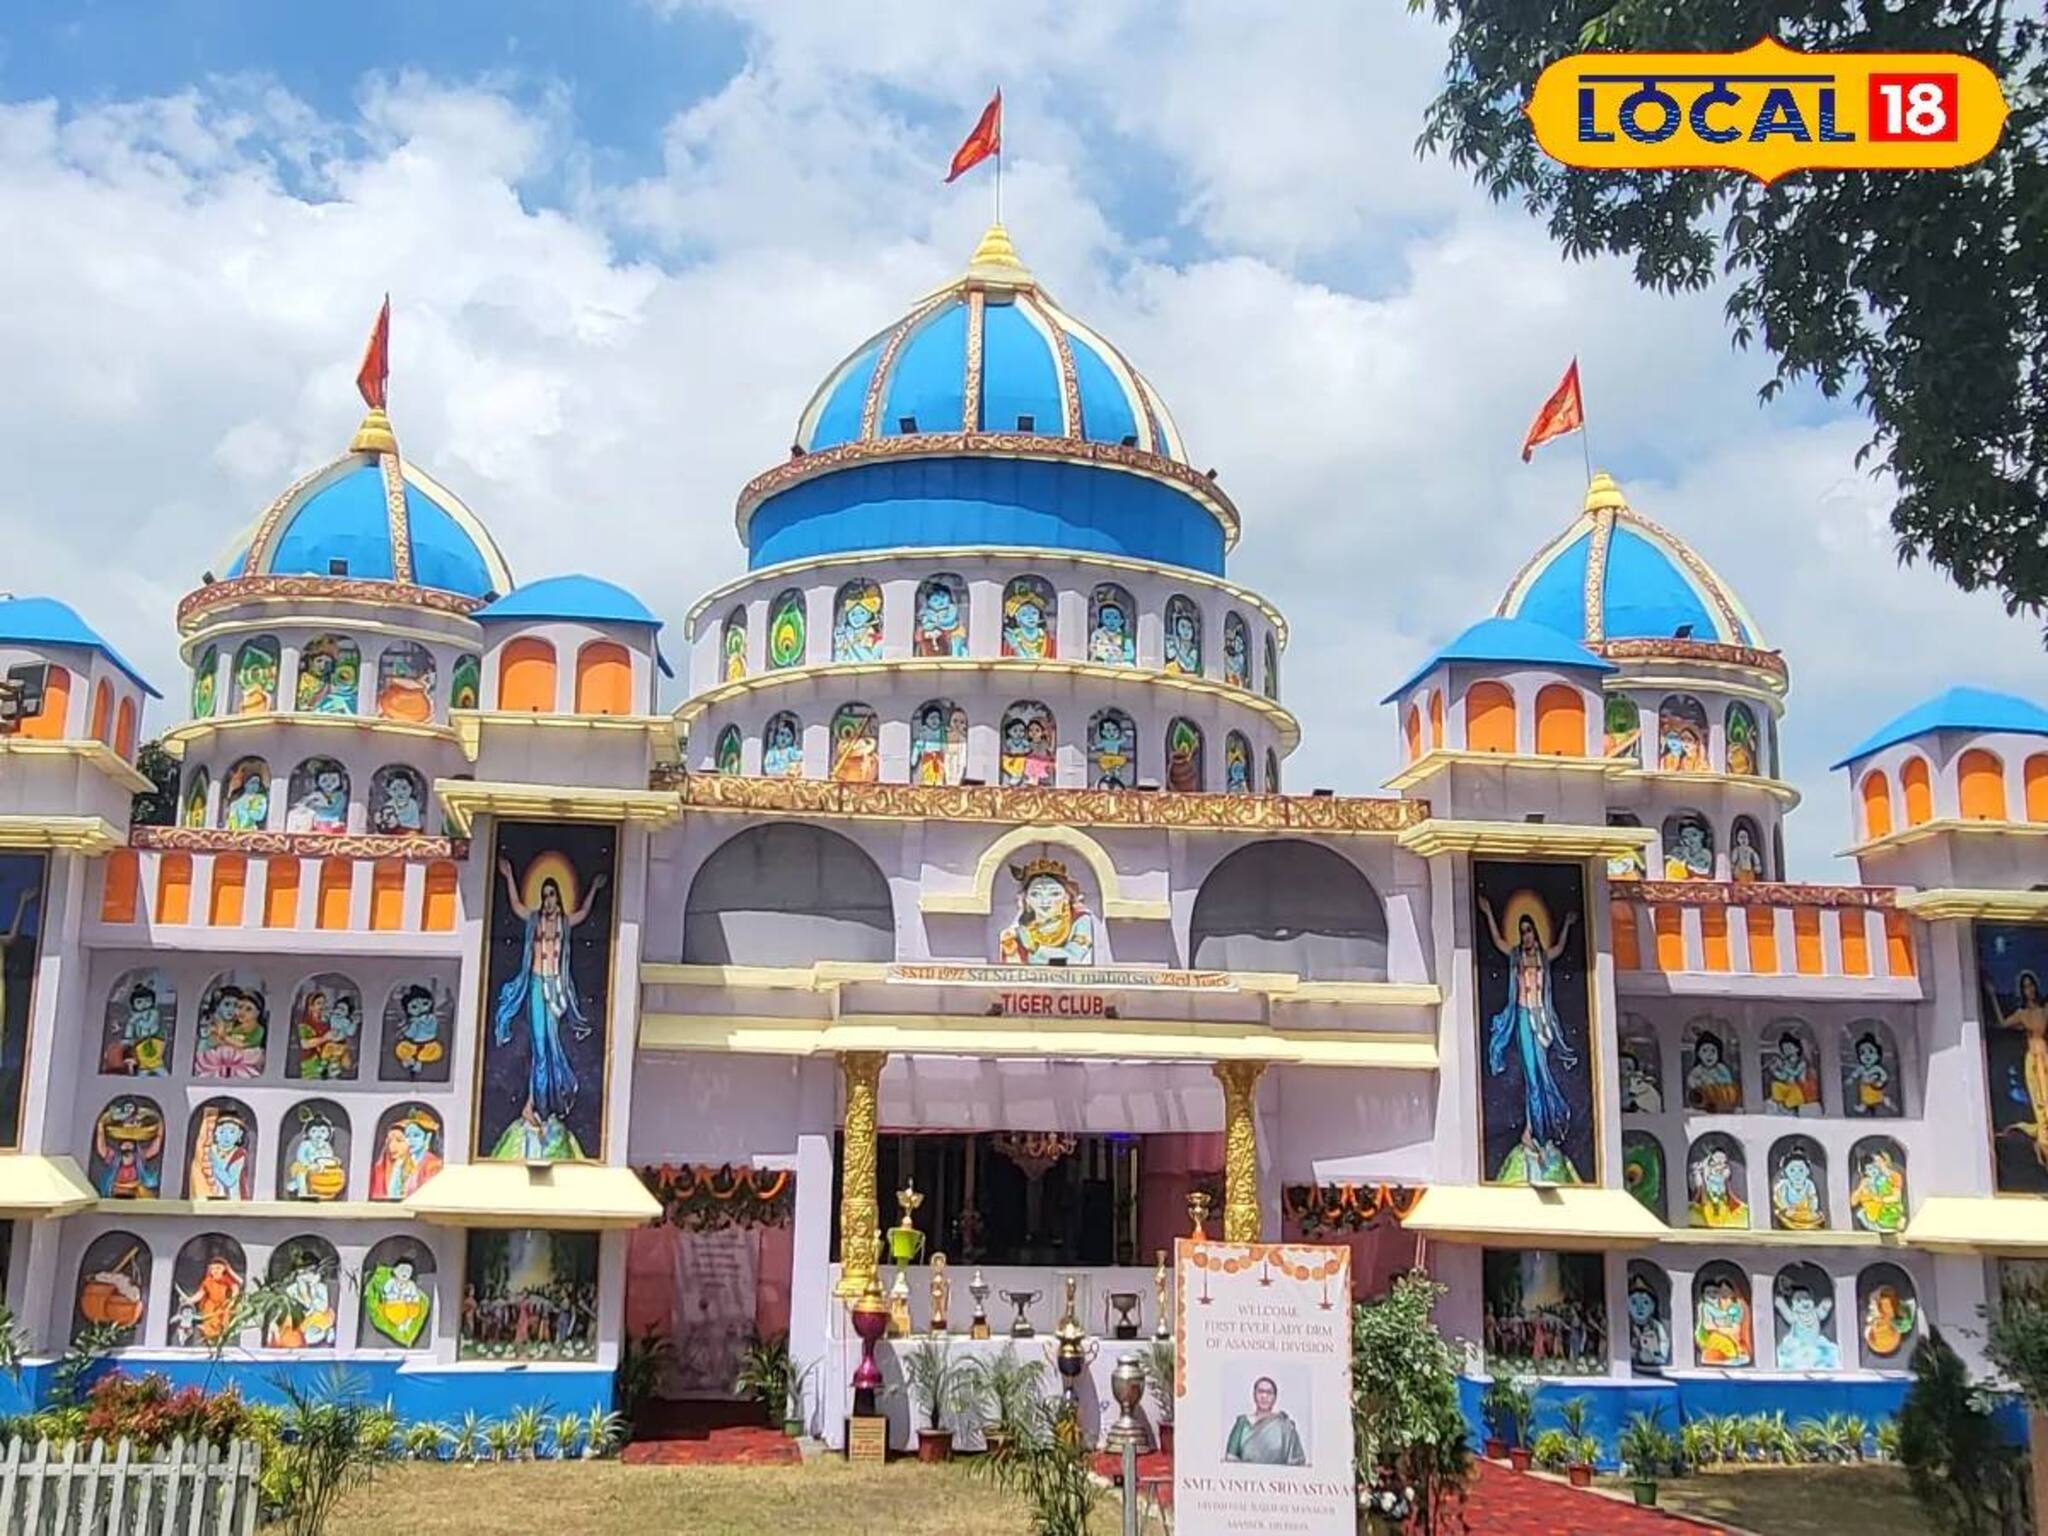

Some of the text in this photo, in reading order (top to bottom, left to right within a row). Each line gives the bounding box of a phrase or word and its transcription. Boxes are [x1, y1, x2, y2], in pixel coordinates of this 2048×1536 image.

[1001, 993, 1104, 1016] TIGER CLUB
[1238, 1304, 1297, 1317] WELCOME
[1204, 1321, 1237, 1333] FIRST
[1240, 1321, 1270, 1333] EVER
[1272, 1323, 1302, 1335] LADY
[1281, 1341, 1335, 1353] DIVISION
